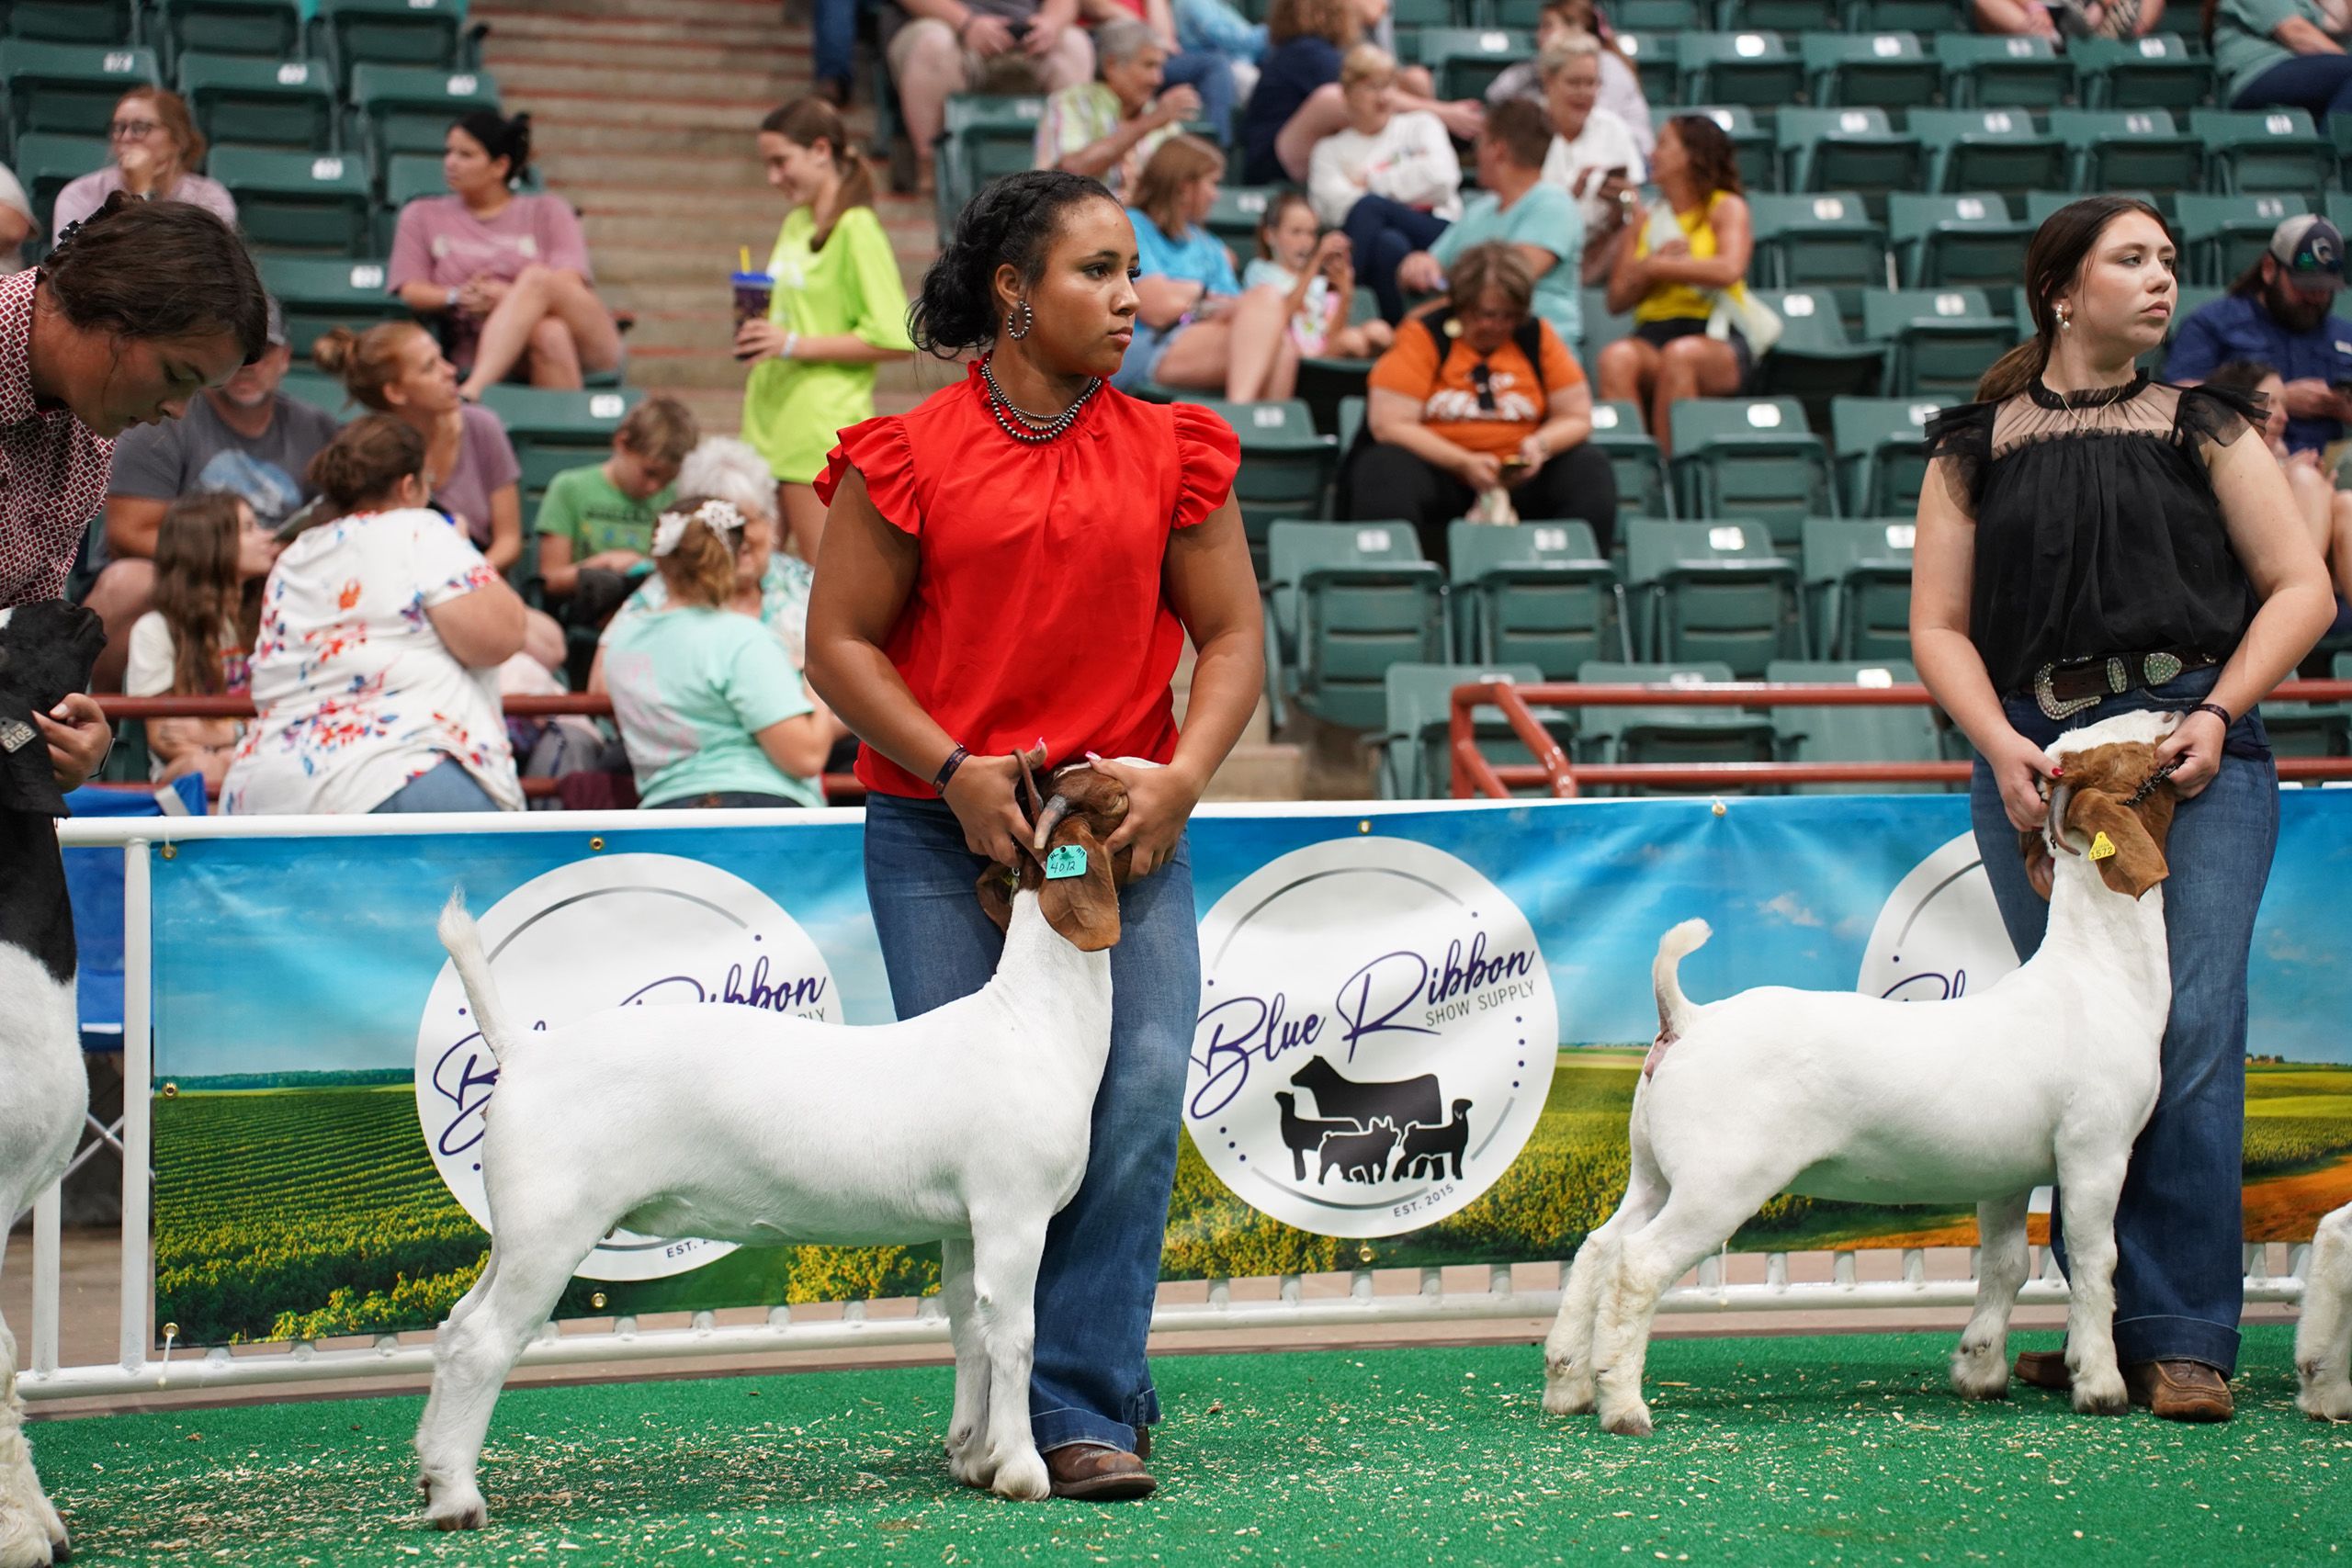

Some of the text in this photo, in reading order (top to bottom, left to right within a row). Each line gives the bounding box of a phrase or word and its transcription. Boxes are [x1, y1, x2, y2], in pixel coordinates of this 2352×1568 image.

[4, 727, 31, 749] 0105
[2091, 847, 2113, 860] 1572
[1050, 861, 1076, 873] 4012
[1425, 979, 1535, 1027] SHOW SUPPLY
[1191, 931, 1535, 1120] Blue Ribbon
[1393, 1183, 1453, 1217] EST. 2015
[666, 1241, 697, 1258] EST.
